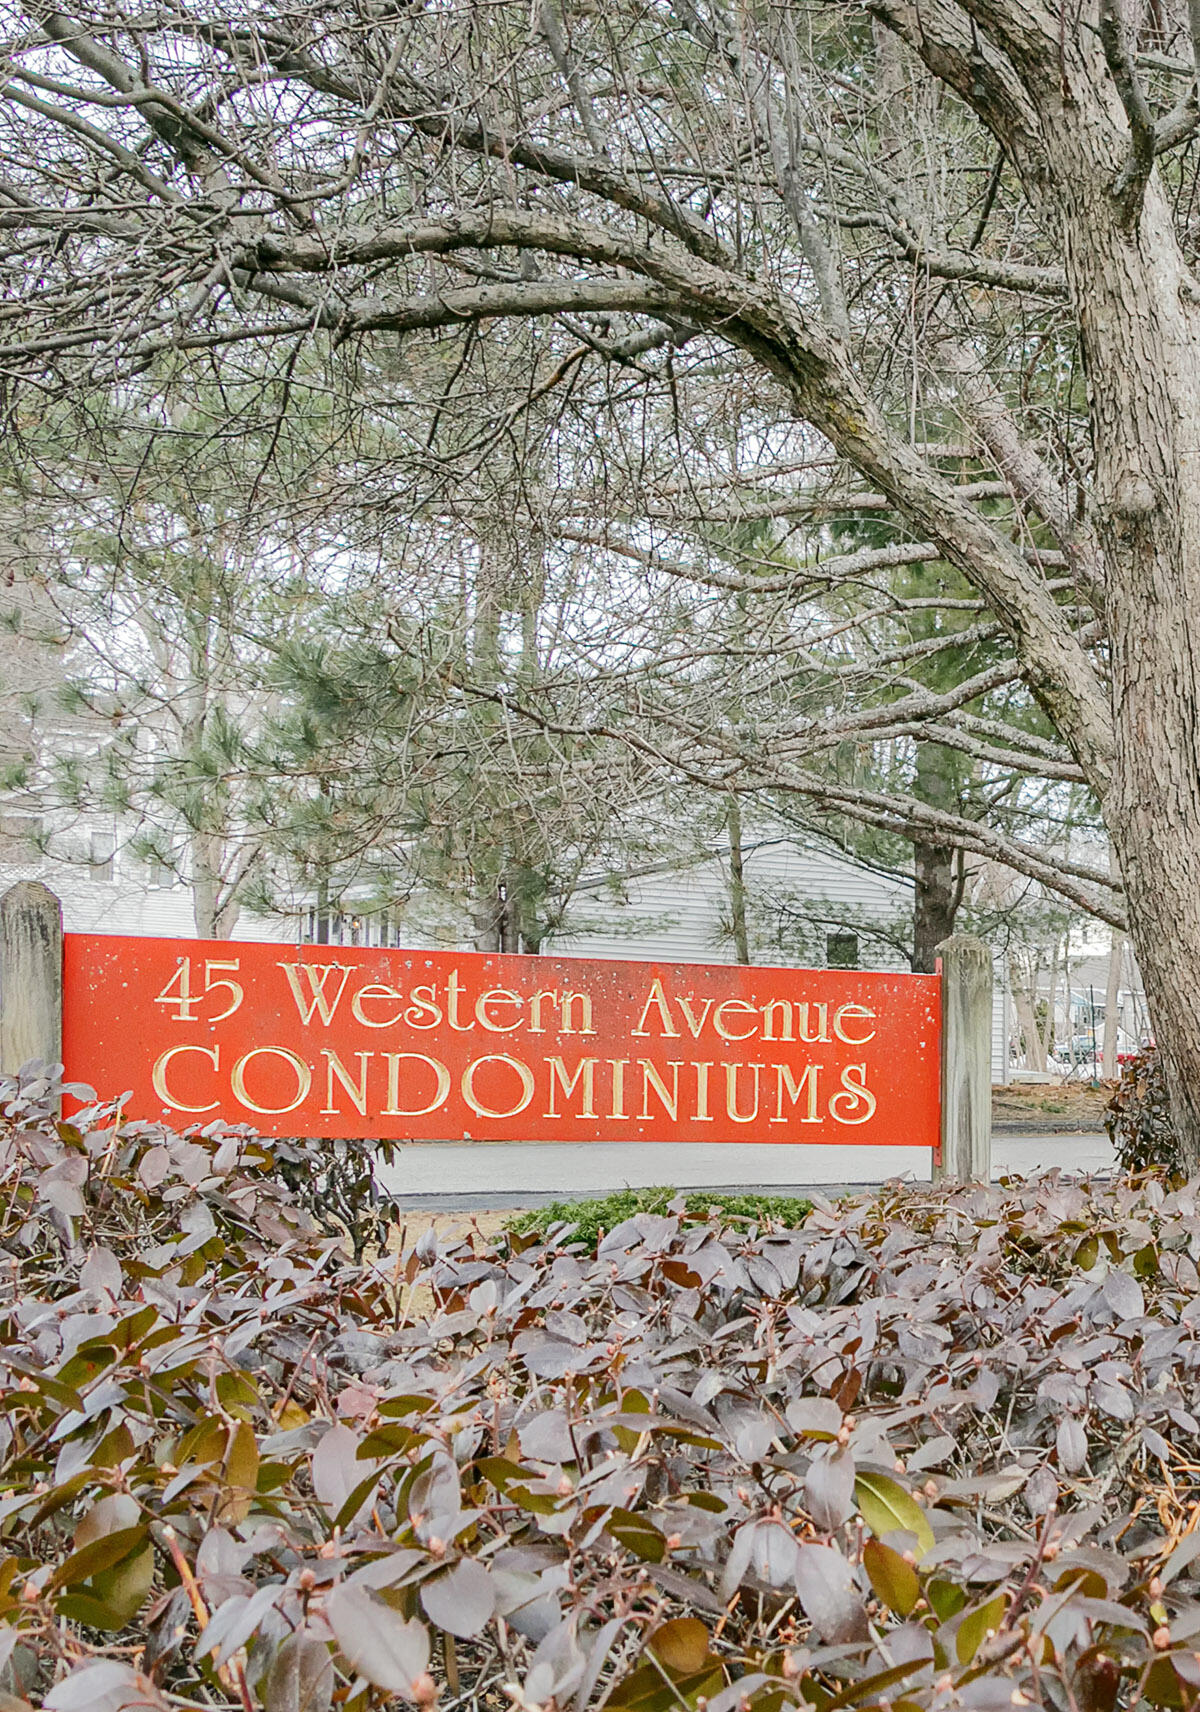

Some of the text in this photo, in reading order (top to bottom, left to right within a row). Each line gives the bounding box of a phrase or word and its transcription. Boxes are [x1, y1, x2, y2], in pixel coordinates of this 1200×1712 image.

[154, 954, 877, 1046] 45 Western Avenue
[151, 1044, 878, 1126] CONDOMINIUMS
